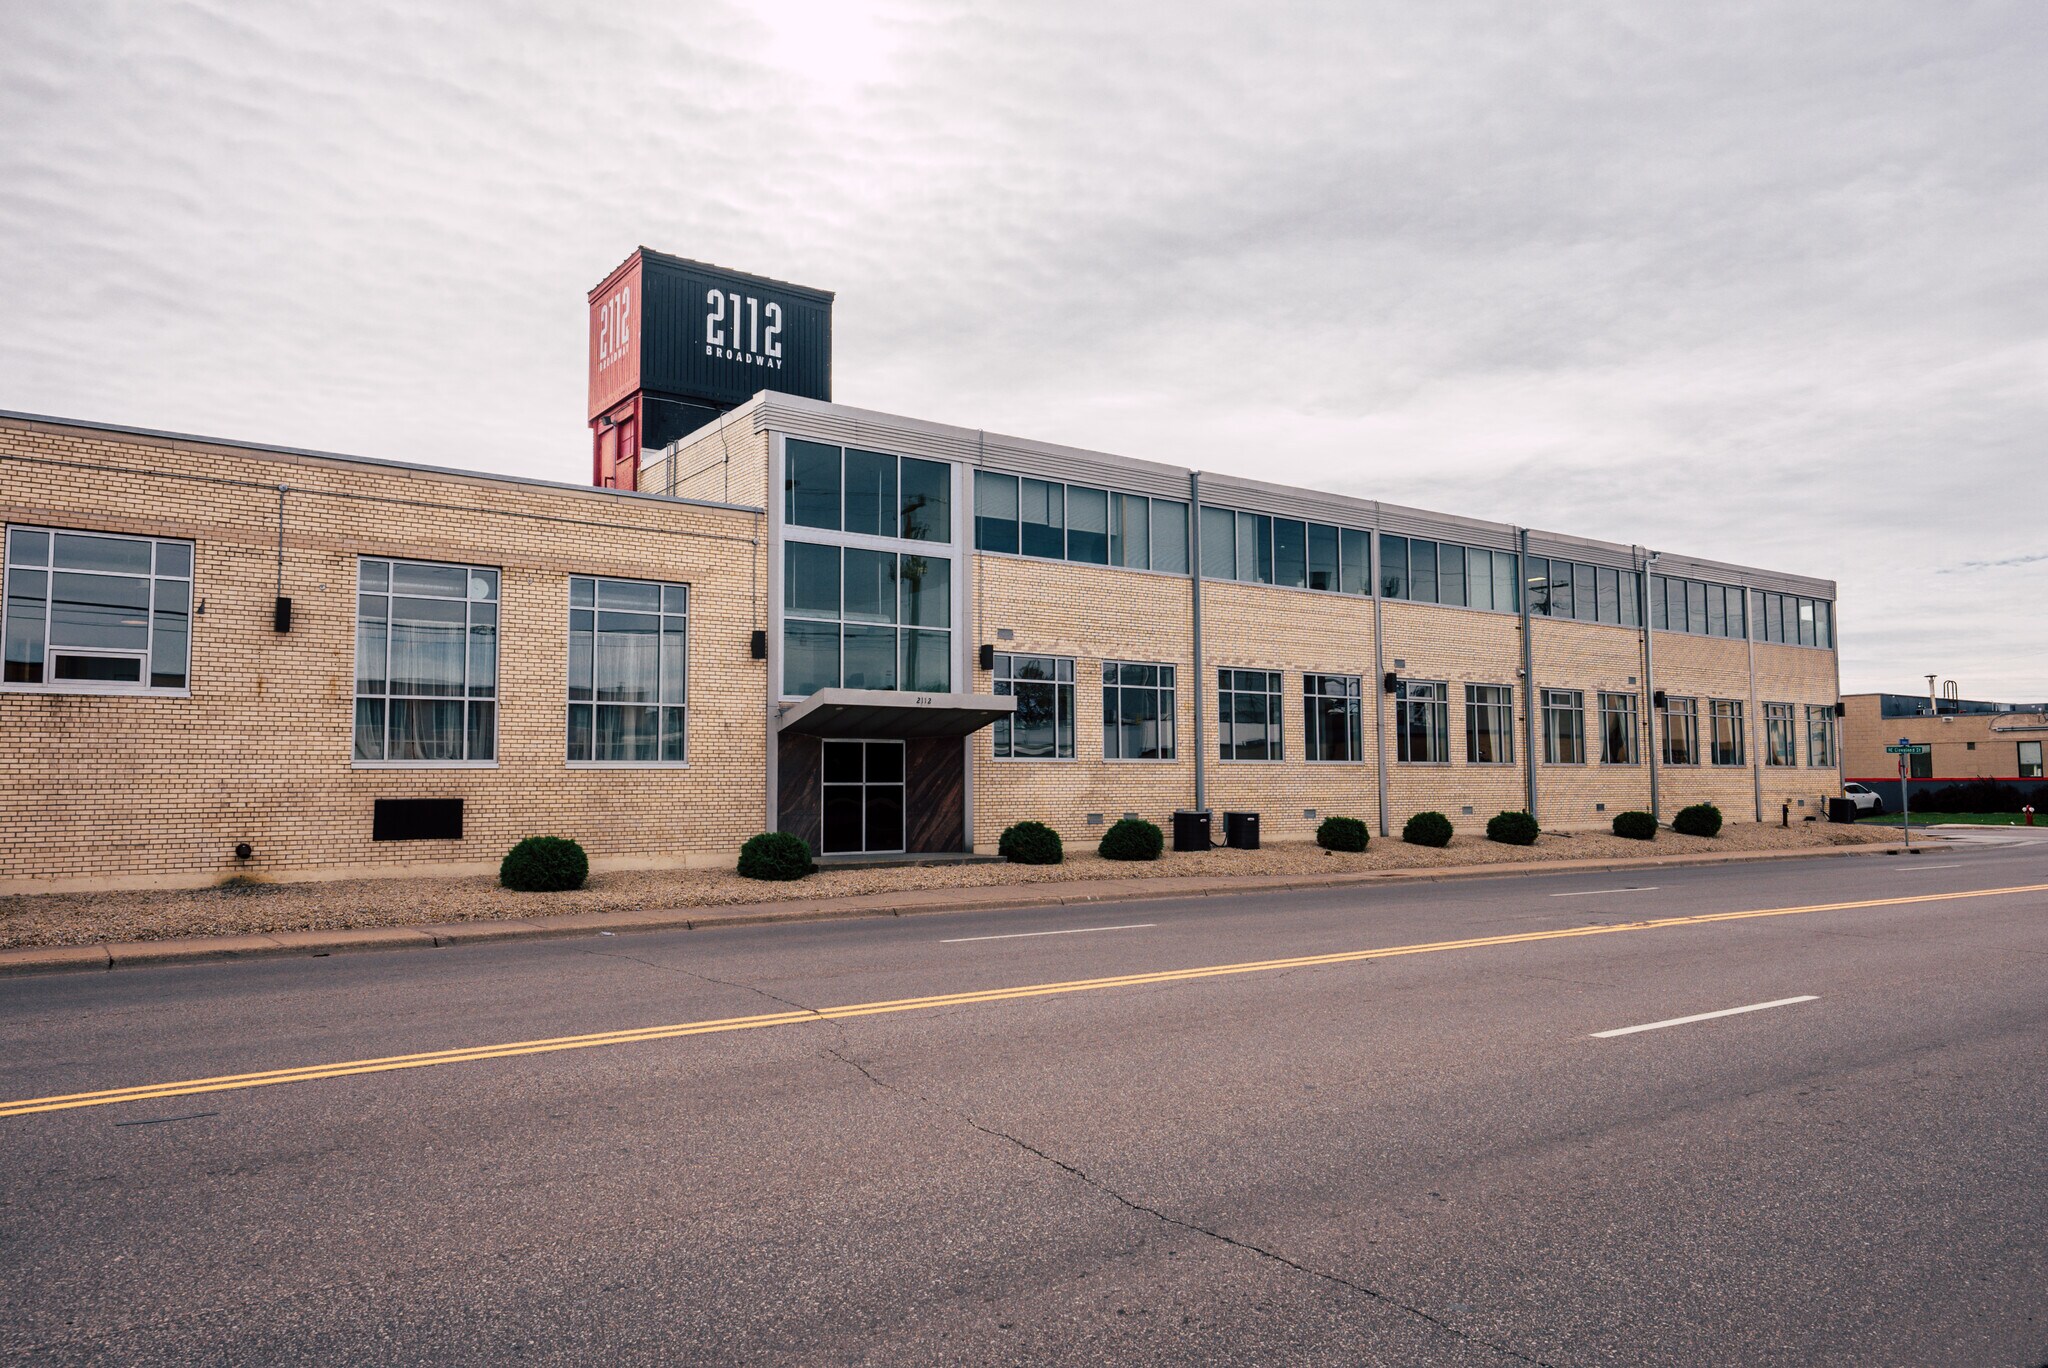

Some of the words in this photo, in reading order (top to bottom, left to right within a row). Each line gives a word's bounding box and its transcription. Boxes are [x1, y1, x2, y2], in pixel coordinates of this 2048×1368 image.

[600, 286, 630, 360] 2112
[706, 289, 782, 358] 2112
[706, 345, 782, 370] BROADWAY
